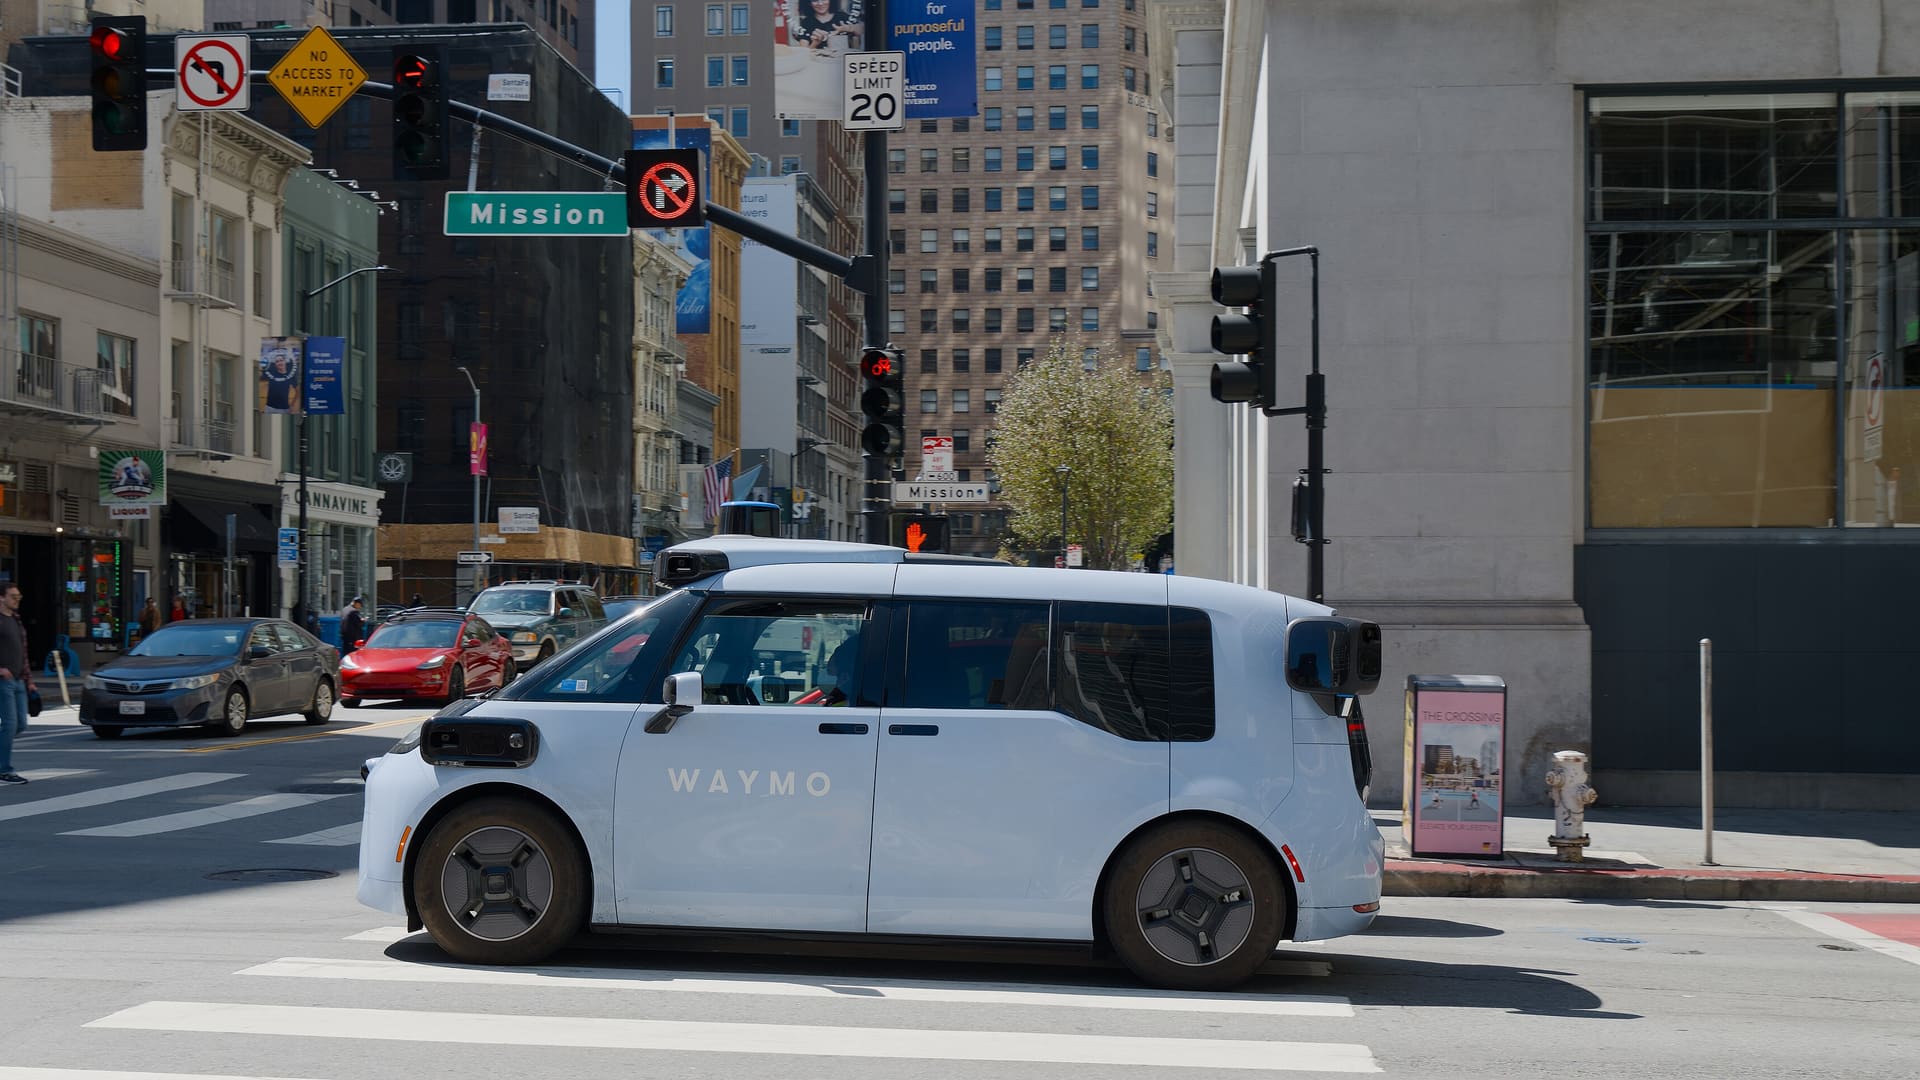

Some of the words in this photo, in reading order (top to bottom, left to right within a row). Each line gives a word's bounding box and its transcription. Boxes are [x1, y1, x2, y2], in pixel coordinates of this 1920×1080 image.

[926, 2, 946, 15] for
[894, 18, 965, 37] purposeful
[909, 37, 956, 54] people.
[310, 50, 328, 62] NO
[849, 61, 899, 74] SPEED
[282, 68, 332, 80] ACCESS
[339, 68, 354, 80] TO
[854, 77, 893, 89] LIMIT
[292, 85, 343, 97] MARKET
[850, 92, 896, 121] 20
[470, 203, 604, 225] Mission
[741, 209, 768, 218] wers
[909, 486, 975, 498] Mission
[111, 507, 148, 516] LIQUOR
[1422, 711, 1443, 721] THE
[1444, 711, 1502, 723] CROSSING
[667, 767, 831, 797] WAYMO
